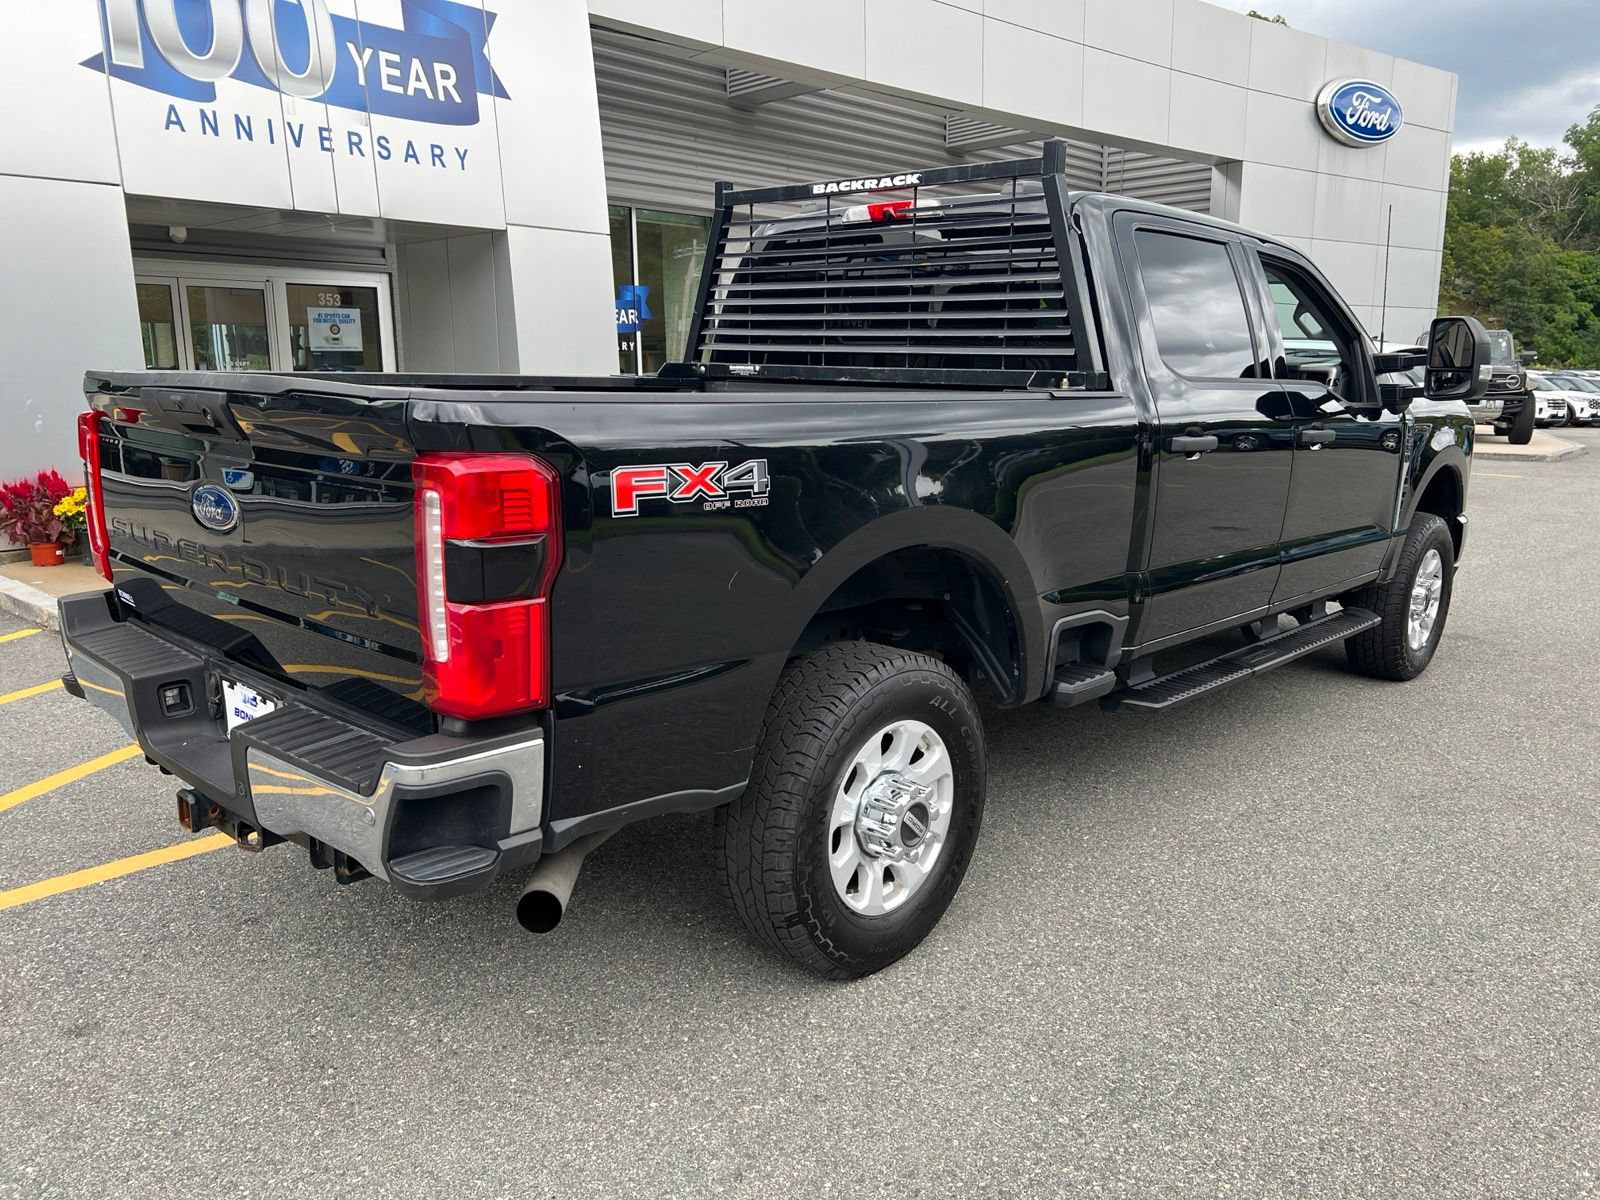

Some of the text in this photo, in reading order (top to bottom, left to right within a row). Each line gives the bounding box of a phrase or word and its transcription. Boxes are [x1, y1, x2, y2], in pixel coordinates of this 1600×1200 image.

[345, 41, 463, 104] YEAR
[1346, 91, 1392, 131] Ford
[164, 104, 469, 171] ANNIVERSARY
[812, 173, 921, 195] BACKRACK
[318, 293, 342, 306] 353
[610, 459, 770, 518] FX4
[703, 497, 769, 511] OFF ROAD
[196, 493, 225, 521] Ford
[111, 516, 391, 620] SUPER DUTY
[929, 694, 957, 720] ALL
